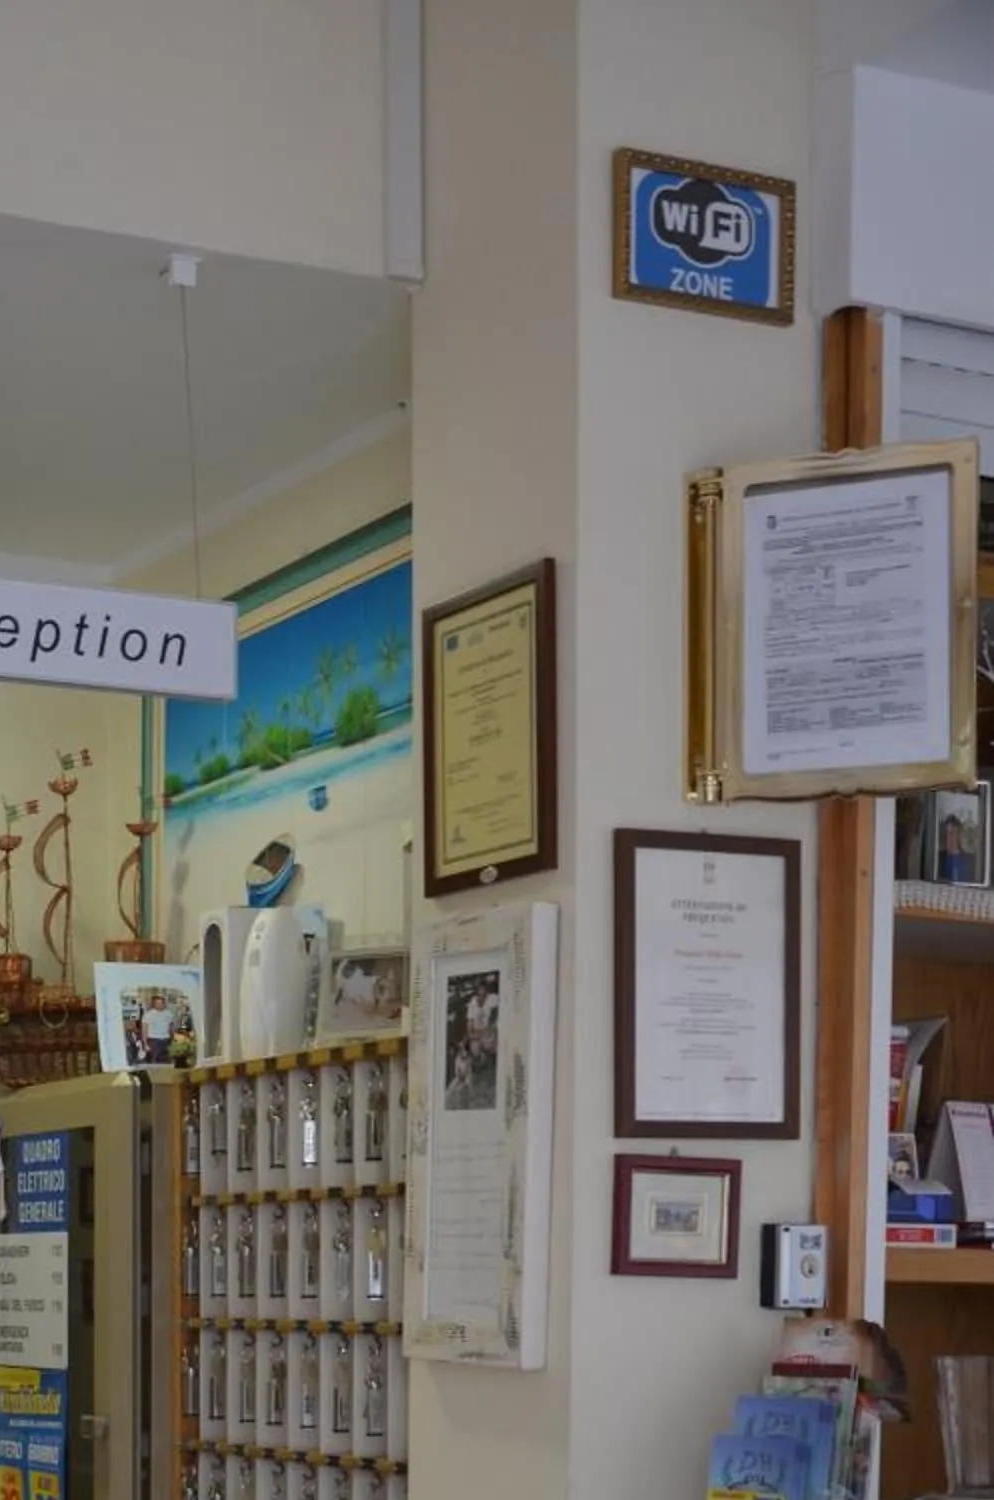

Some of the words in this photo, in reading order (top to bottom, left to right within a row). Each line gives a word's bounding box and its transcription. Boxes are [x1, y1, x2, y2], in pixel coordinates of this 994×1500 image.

[670, 268, 734, 301] ZONE
[22, 1138, 61, 1163] QUADRO
[17, 1168, 65, 1194] ELETTRICO
[19, 1199, 65, 1223] GENERALE
